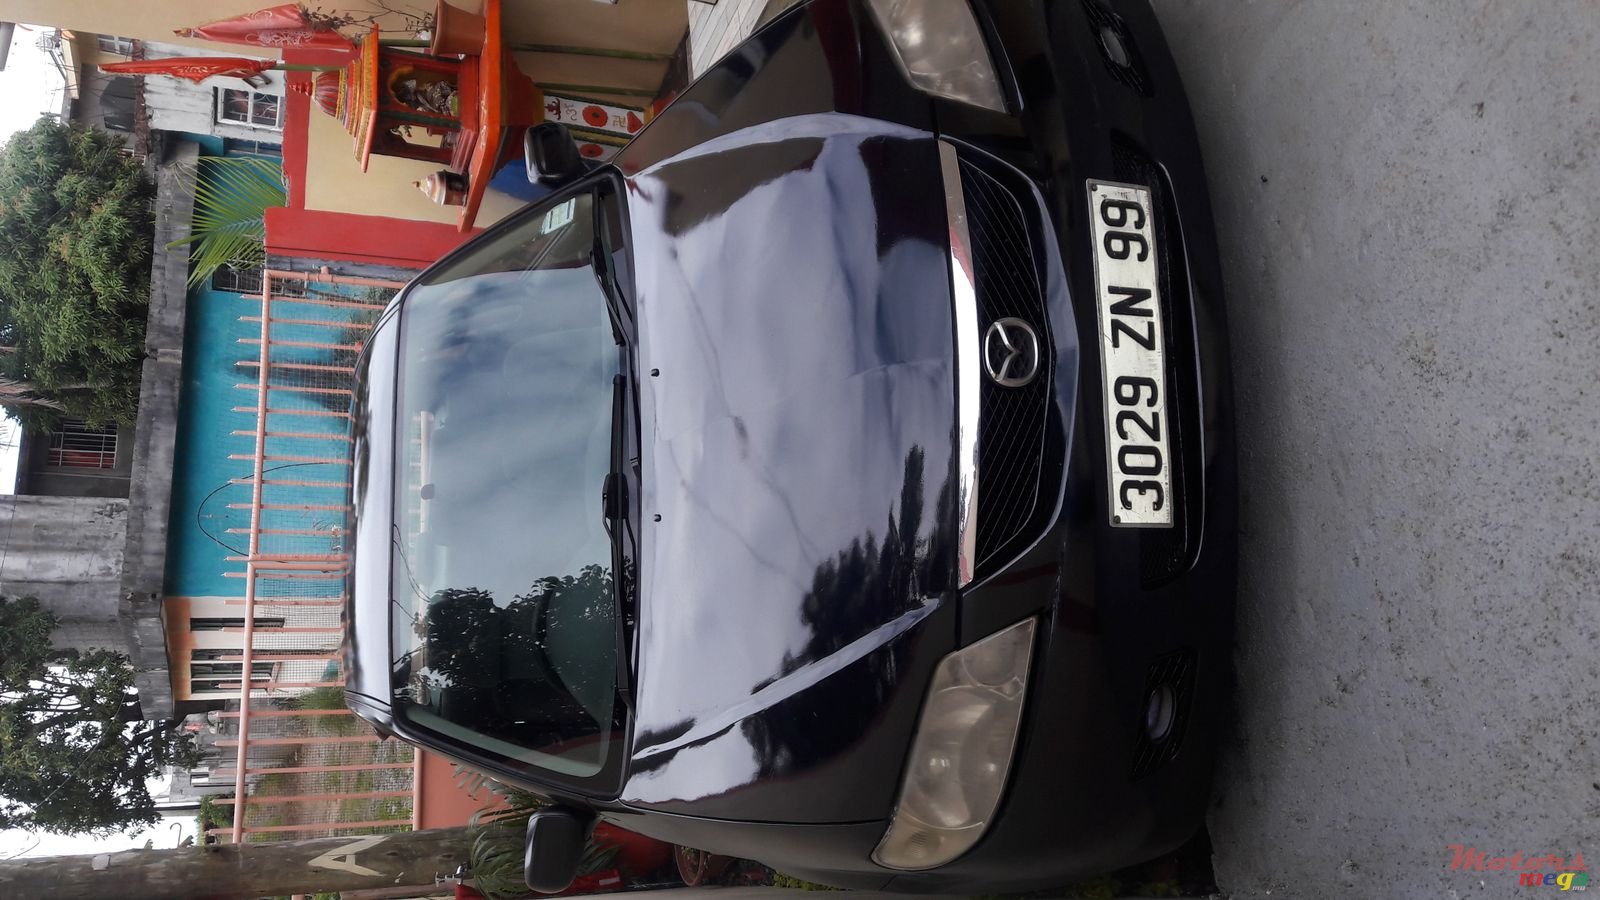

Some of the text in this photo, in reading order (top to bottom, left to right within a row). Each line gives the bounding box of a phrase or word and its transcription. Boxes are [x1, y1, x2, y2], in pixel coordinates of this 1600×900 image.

[1100, 199, 1165, 512] 3029 ZN 99
